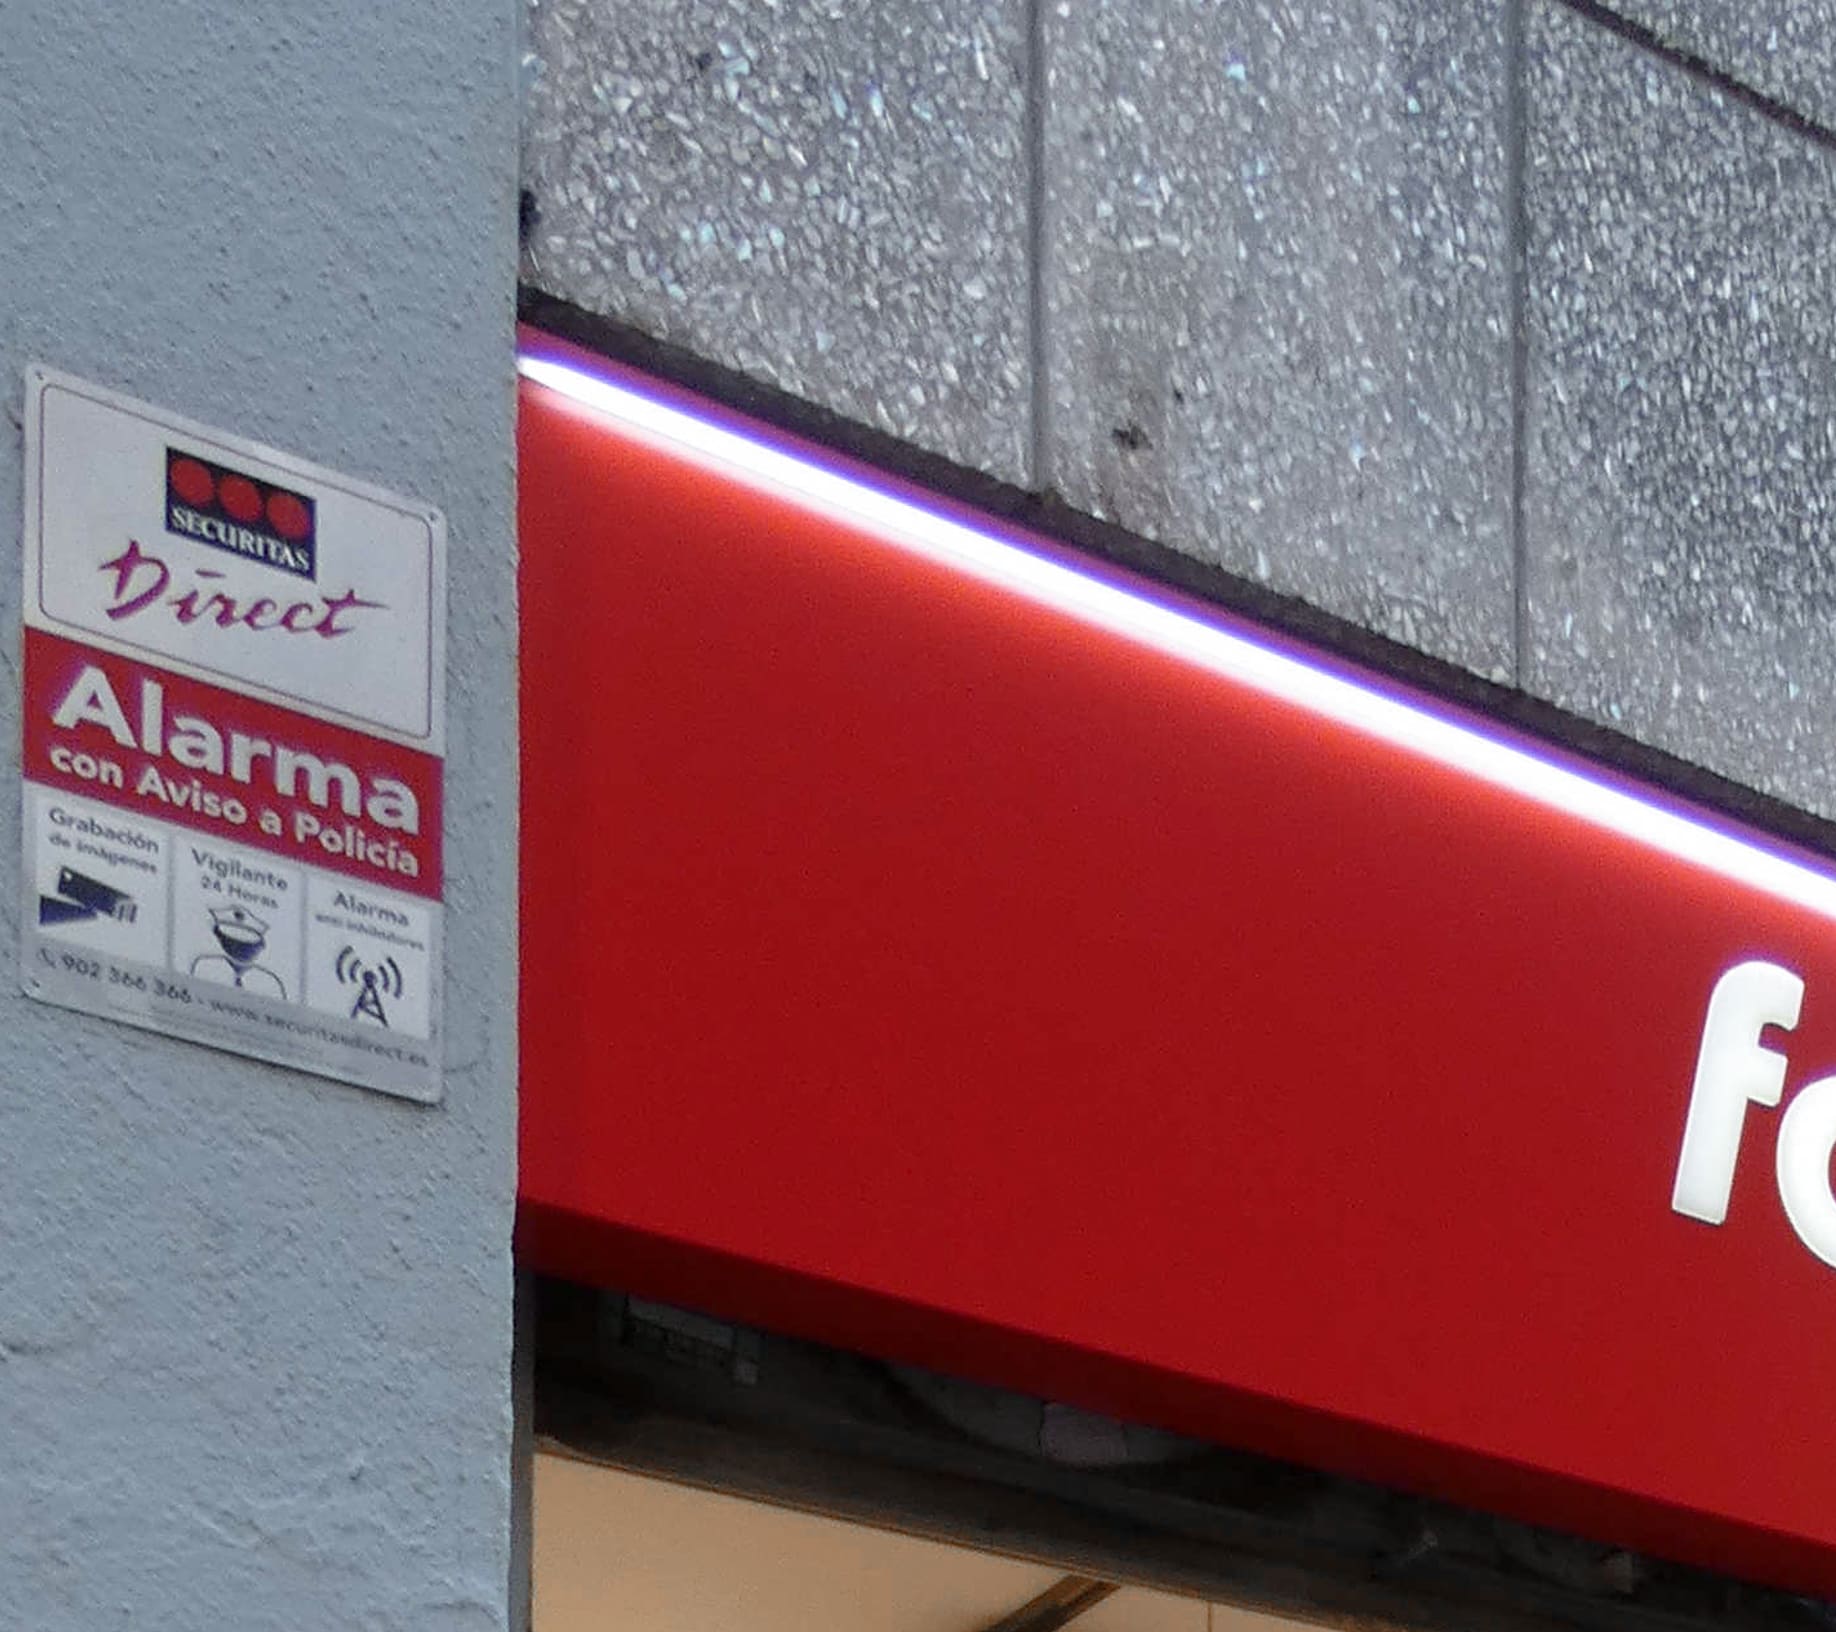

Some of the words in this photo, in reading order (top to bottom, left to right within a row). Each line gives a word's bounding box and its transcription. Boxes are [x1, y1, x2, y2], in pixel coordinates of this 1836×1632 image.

[170, 505, 311, 572] SECURITAS
[99, 538, 390, 638] Direct
[51, 663, 421, 836] Alarma
[49, 746, 124, 789] con
[136, 766, 248, 825] Aviso
[258, 809, 283, 837] a
[48, 832, 71, 849] de
[49, 807, 160, 853] Grabación
[190, 847, 289, 892] Vigilante
[200, 875, 223, 894] 24
[332, 889, 410, 928] Alarma
[61, 954, 101, 979] 902
